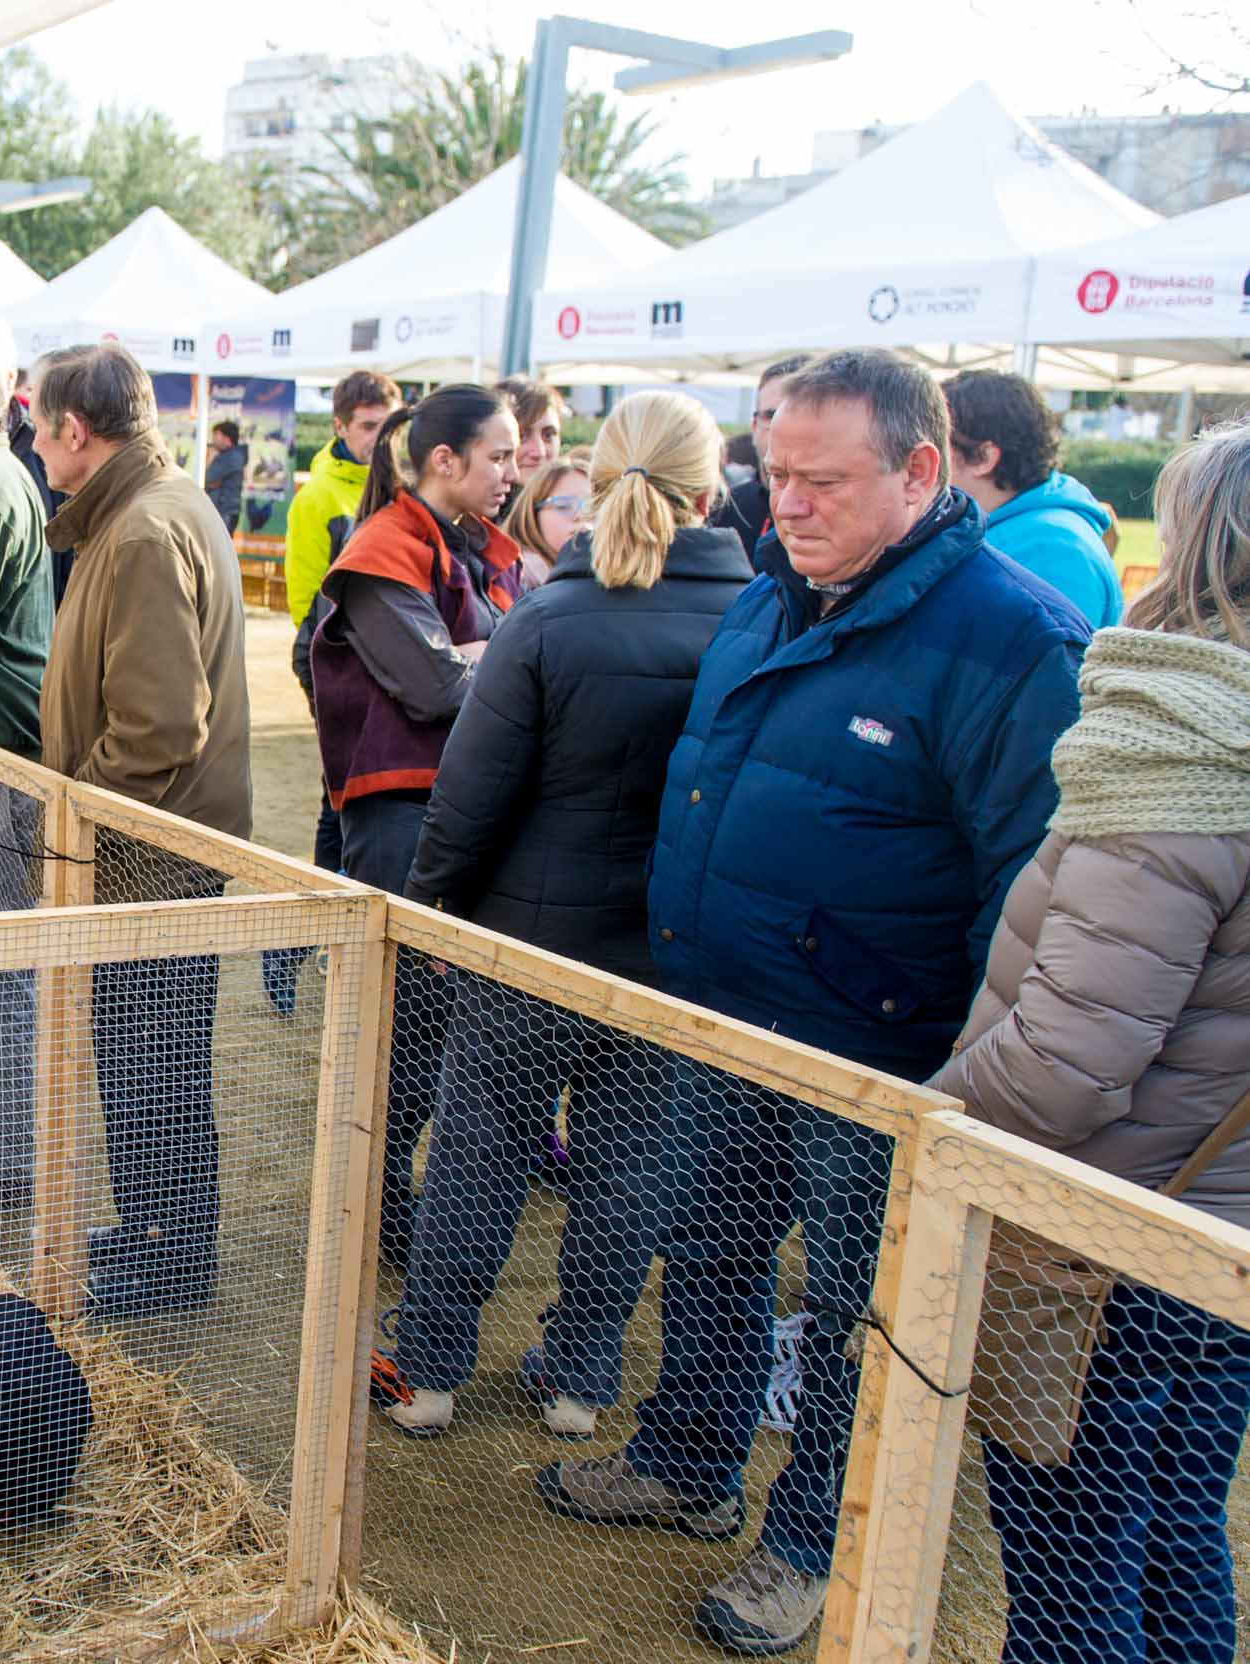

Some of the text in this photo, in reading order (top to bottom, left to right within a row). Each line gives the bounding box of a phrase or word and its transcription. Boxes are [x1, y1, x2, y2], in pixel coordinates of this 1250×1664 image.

[1125, 295, 1214, 308] Barcelona
[652, 301, 681, 324] m
[273, 330, 291, 346] m
[174, 339, 194, 352] m
